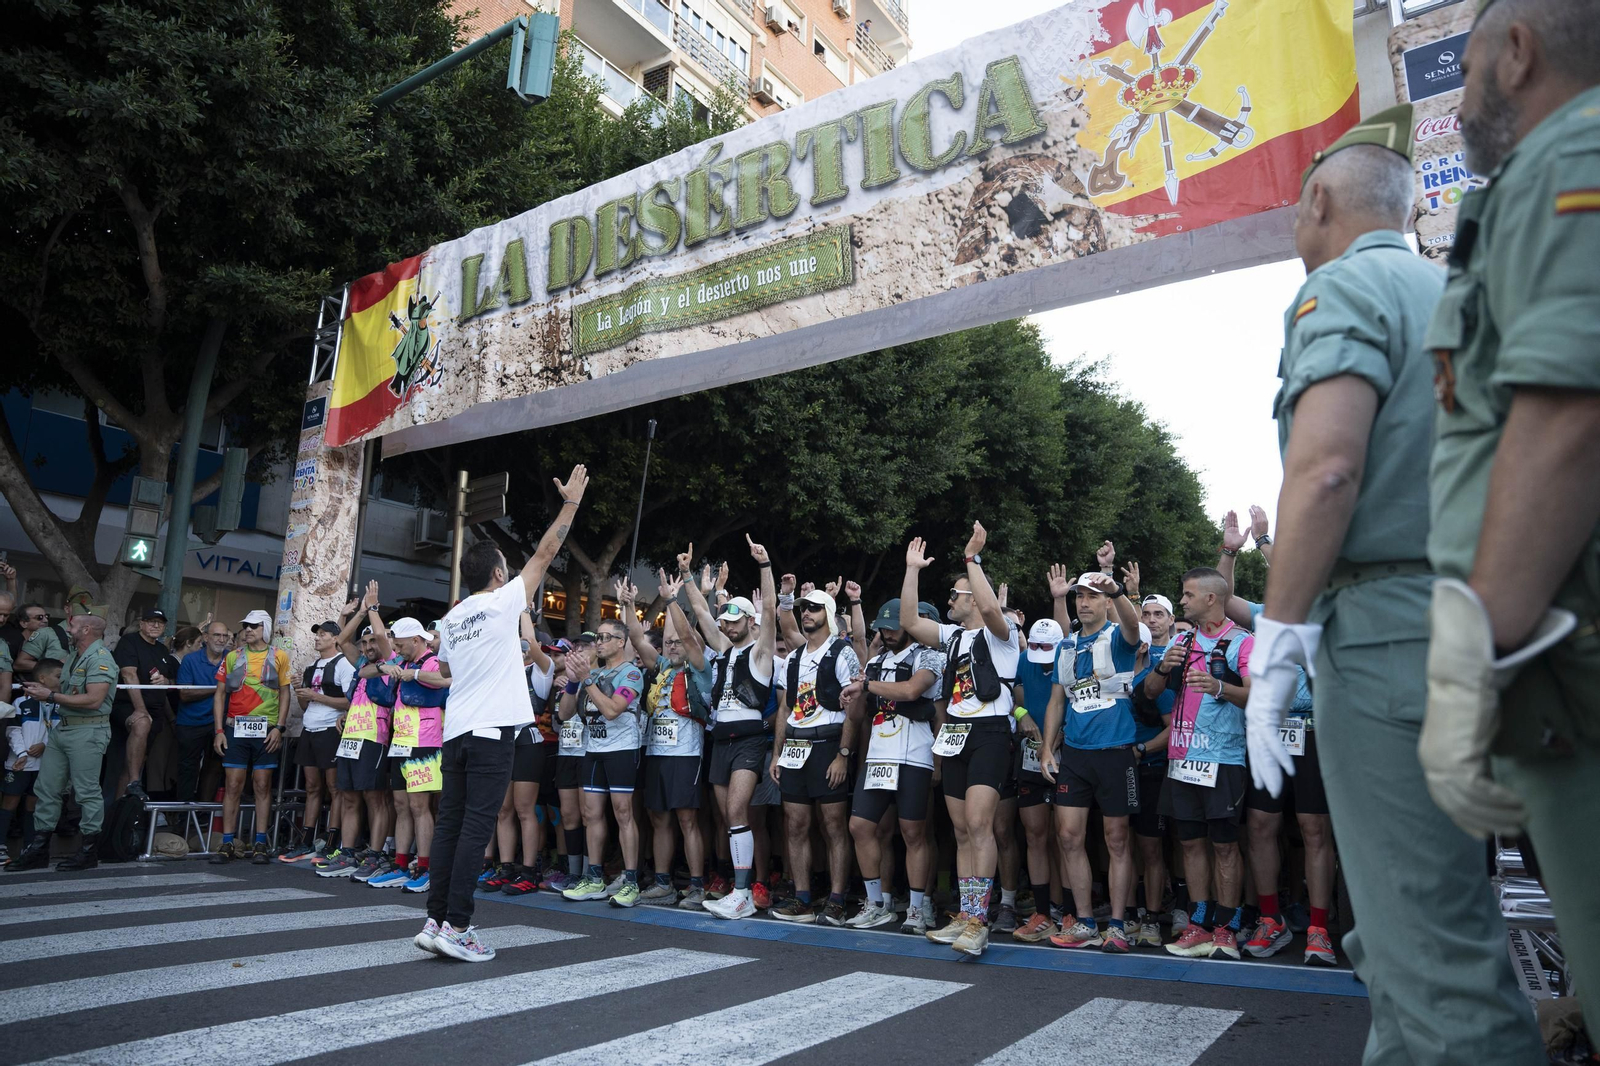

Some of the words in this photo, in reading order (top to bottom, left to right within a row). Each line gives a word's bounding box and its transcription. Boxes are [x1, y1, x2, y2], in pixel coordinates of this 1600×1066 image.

[1422, 153, 1465, 171] GRU
[1423, 166, 1474, 189] REN
[460, 237, 532, 323] LA
[546, 54, 1048, 293] DESÉRTICA
[1425, 186, 1476, 209] TO
[1428, 233, 1456, 245] TORR
[596, 312, 612, 332] La
[619, 296, 652, 326] Legión
[660, 296, 671, 316] y
[678, 287, 690, 309] el
[697, 274, 749, 304] desierto
[756, 265, 782, 286] nos
[789, 256, 817, 277] une
[295, 465, 316, 478] RENTA
[294, 476, 315, 489] TODO
[196, 551, 281, 579] VITAL
[243, 722, 263, 731] 1480
[654, 726, 673, 736] 4388
[944, 734, 965, 746] 4602
[1171, 731, 1210, 750] VIATOR
[787, 748, 806, 758] 4601
[872, 767, 892, 778] 4600
[1181, 760, 1211, 773] 2102
[1508, 928, 1530, 958] POLICIA
[1519, 959, 1543, 991] MILITAR
